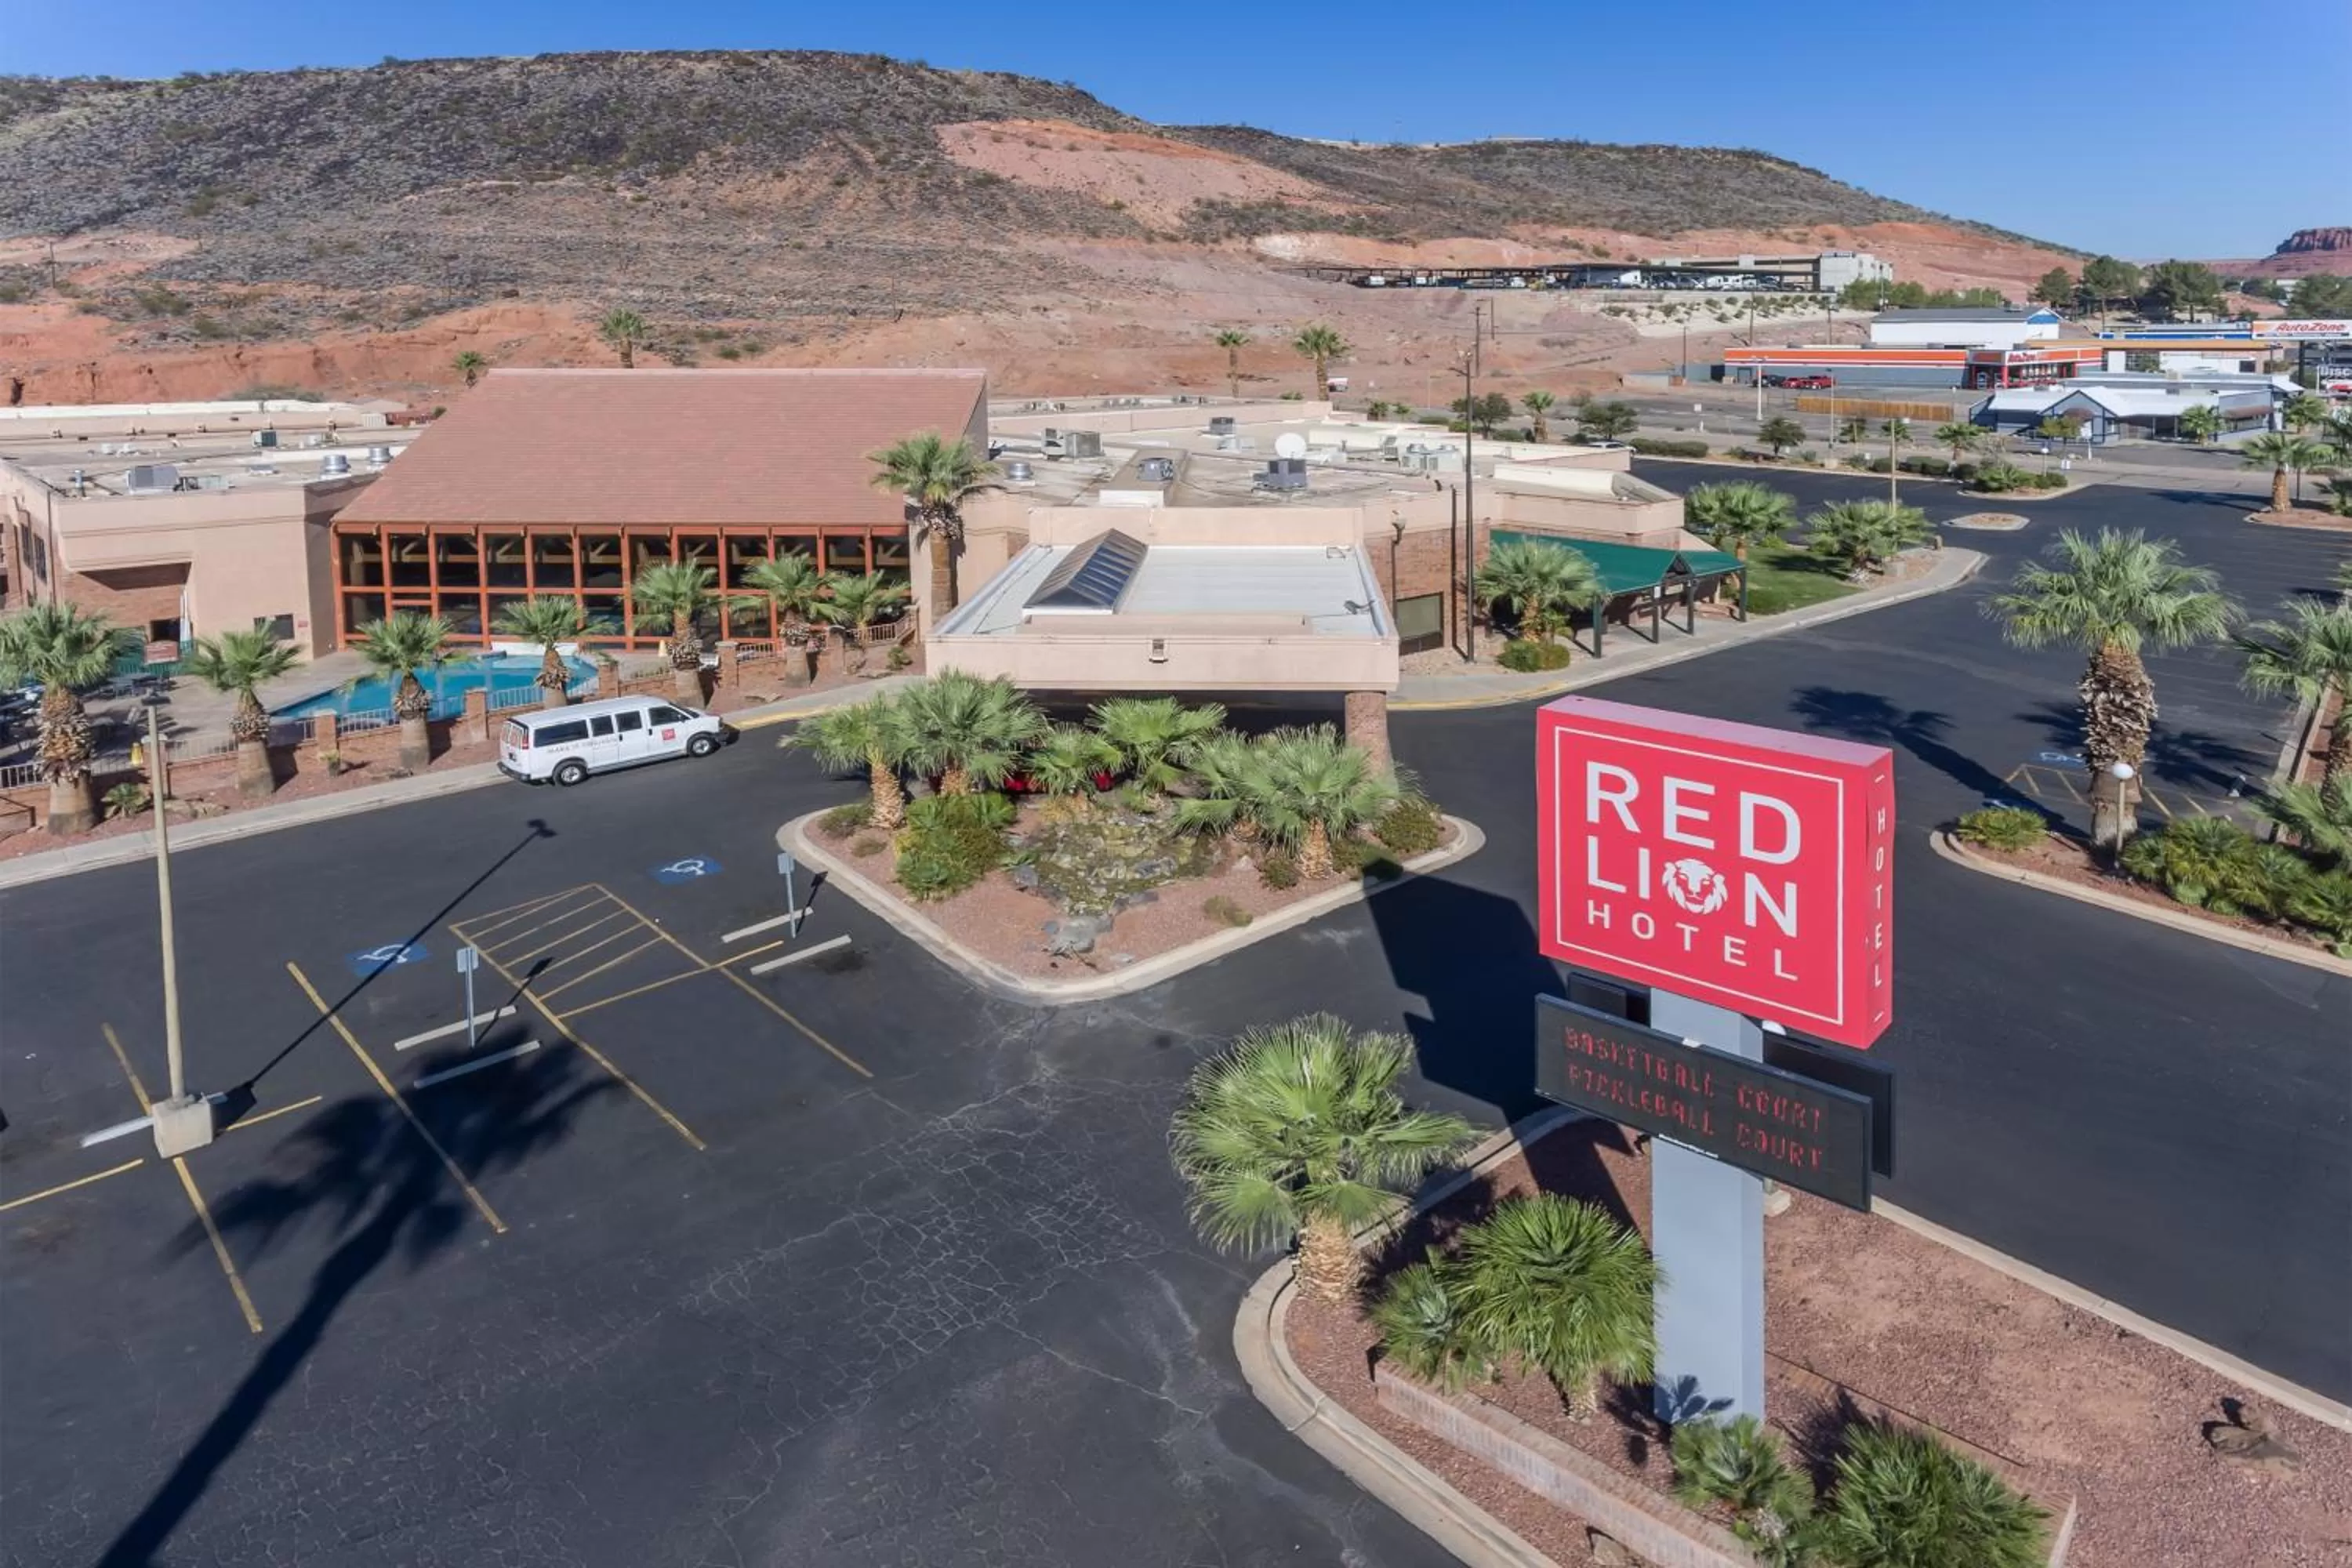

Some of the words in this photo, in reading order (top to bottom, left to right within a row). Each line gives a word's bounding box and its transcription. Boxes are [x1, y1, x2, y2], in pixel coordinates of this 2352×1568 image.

[2276, 322, 2347, 332] AutoZone
[1586, 760, 1802, 865] RED
[1588, 899, 1798, 982] HOTEL
[1875, 807, 1886, 988] HOTEL
[1565, 1025, 1715, 1098] BASKETBALL
[1737, 1083, 1821, 1134] COURT
[1569, 1062, 1715, 1136] PICKLEBALL
[1737, 1123, 1823, 1169] COURT
